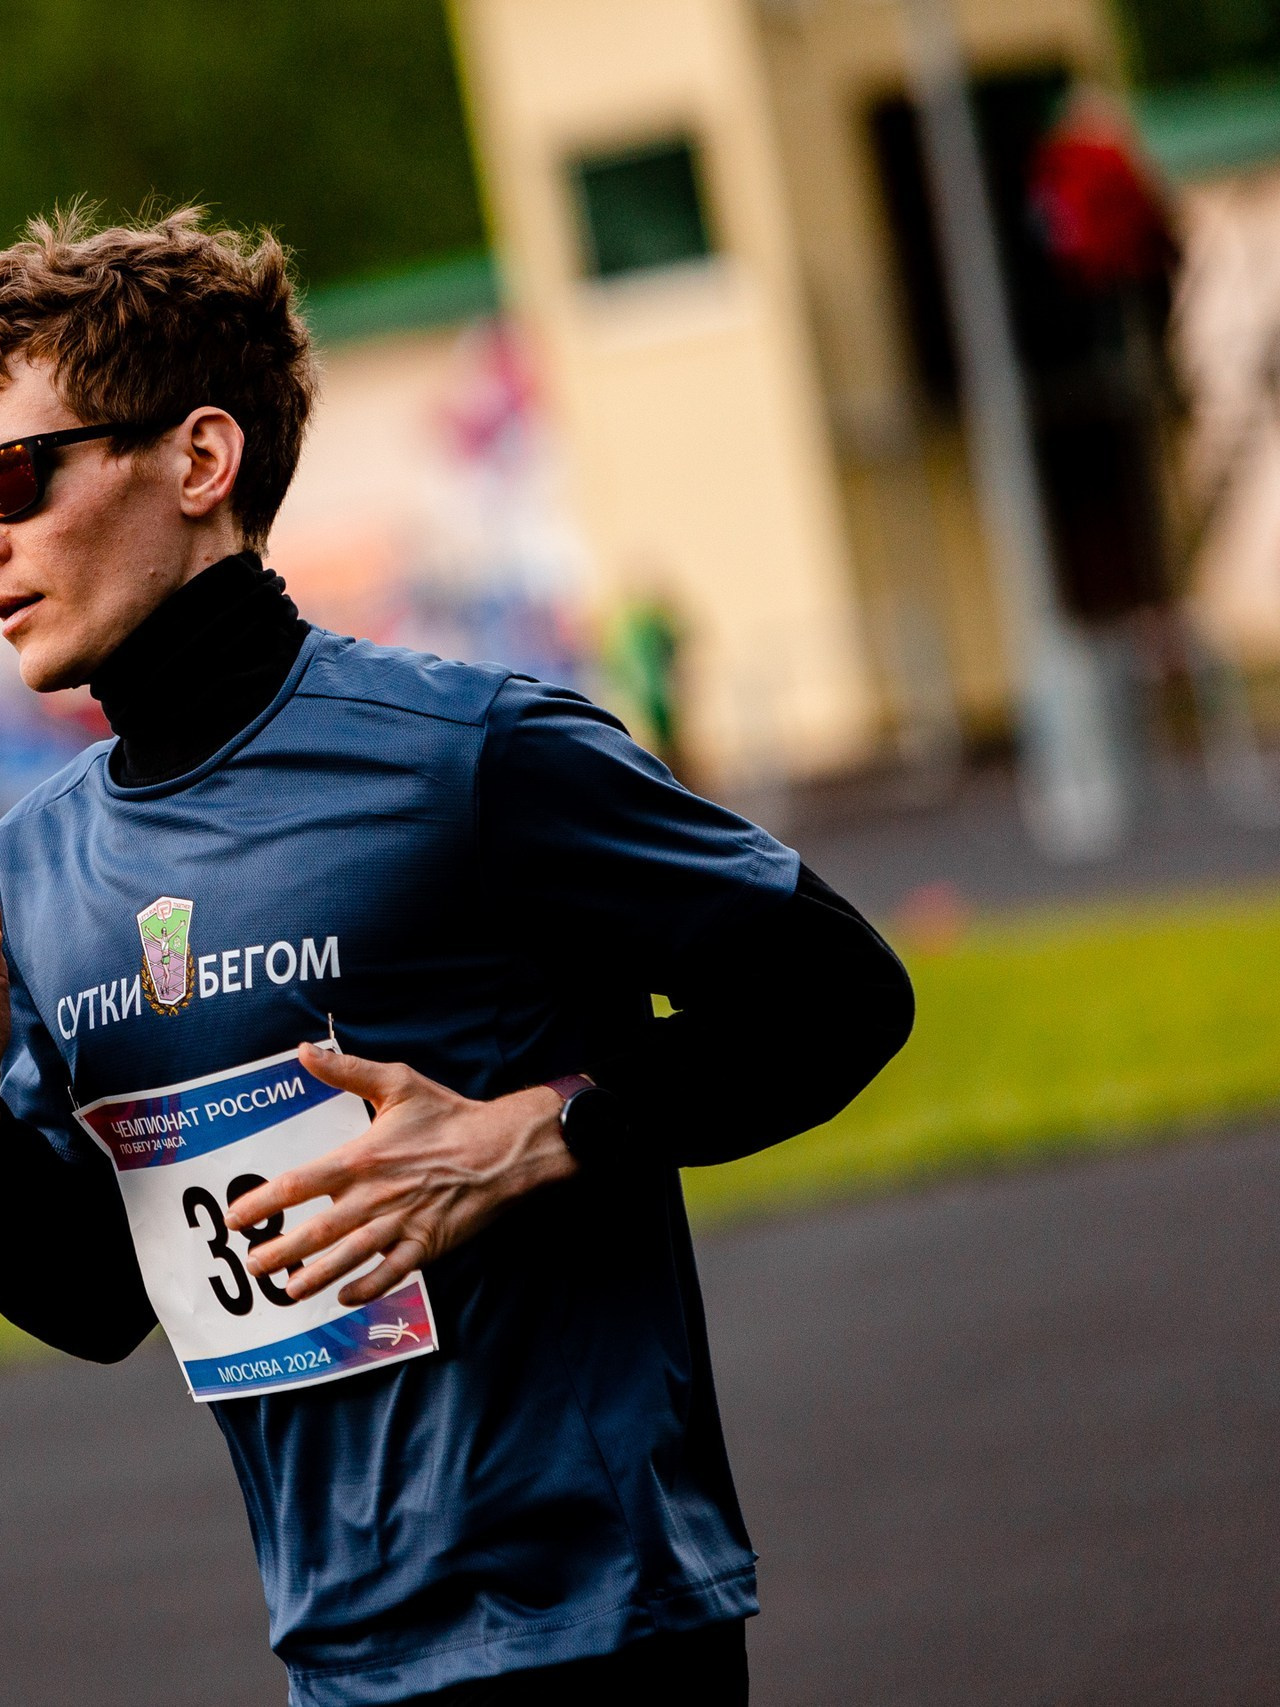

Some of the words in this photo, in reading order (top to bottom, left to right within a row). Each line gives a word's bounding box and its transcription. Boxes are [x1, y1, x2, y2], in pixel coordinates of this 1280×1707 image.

[57, 974, 142, 1040] СУТКИ
[198, 936, 341, 999] БЕГОМ
[111, 1107, 199, 1139] ЧЕМПИОНАТ
[205, 1077, 306, 1122] РОССИИ
[120, 1143, 132, 1155] ПО
[132, 1141, 151, 1153] БЕГУ
[151, 1139, 163, 1151] 24
[162, 1135, 187, 1149] ЧАСА
[217, 1359, 284, 1384] МОСКВА
[283, 1347, 332, 1374] 2024
